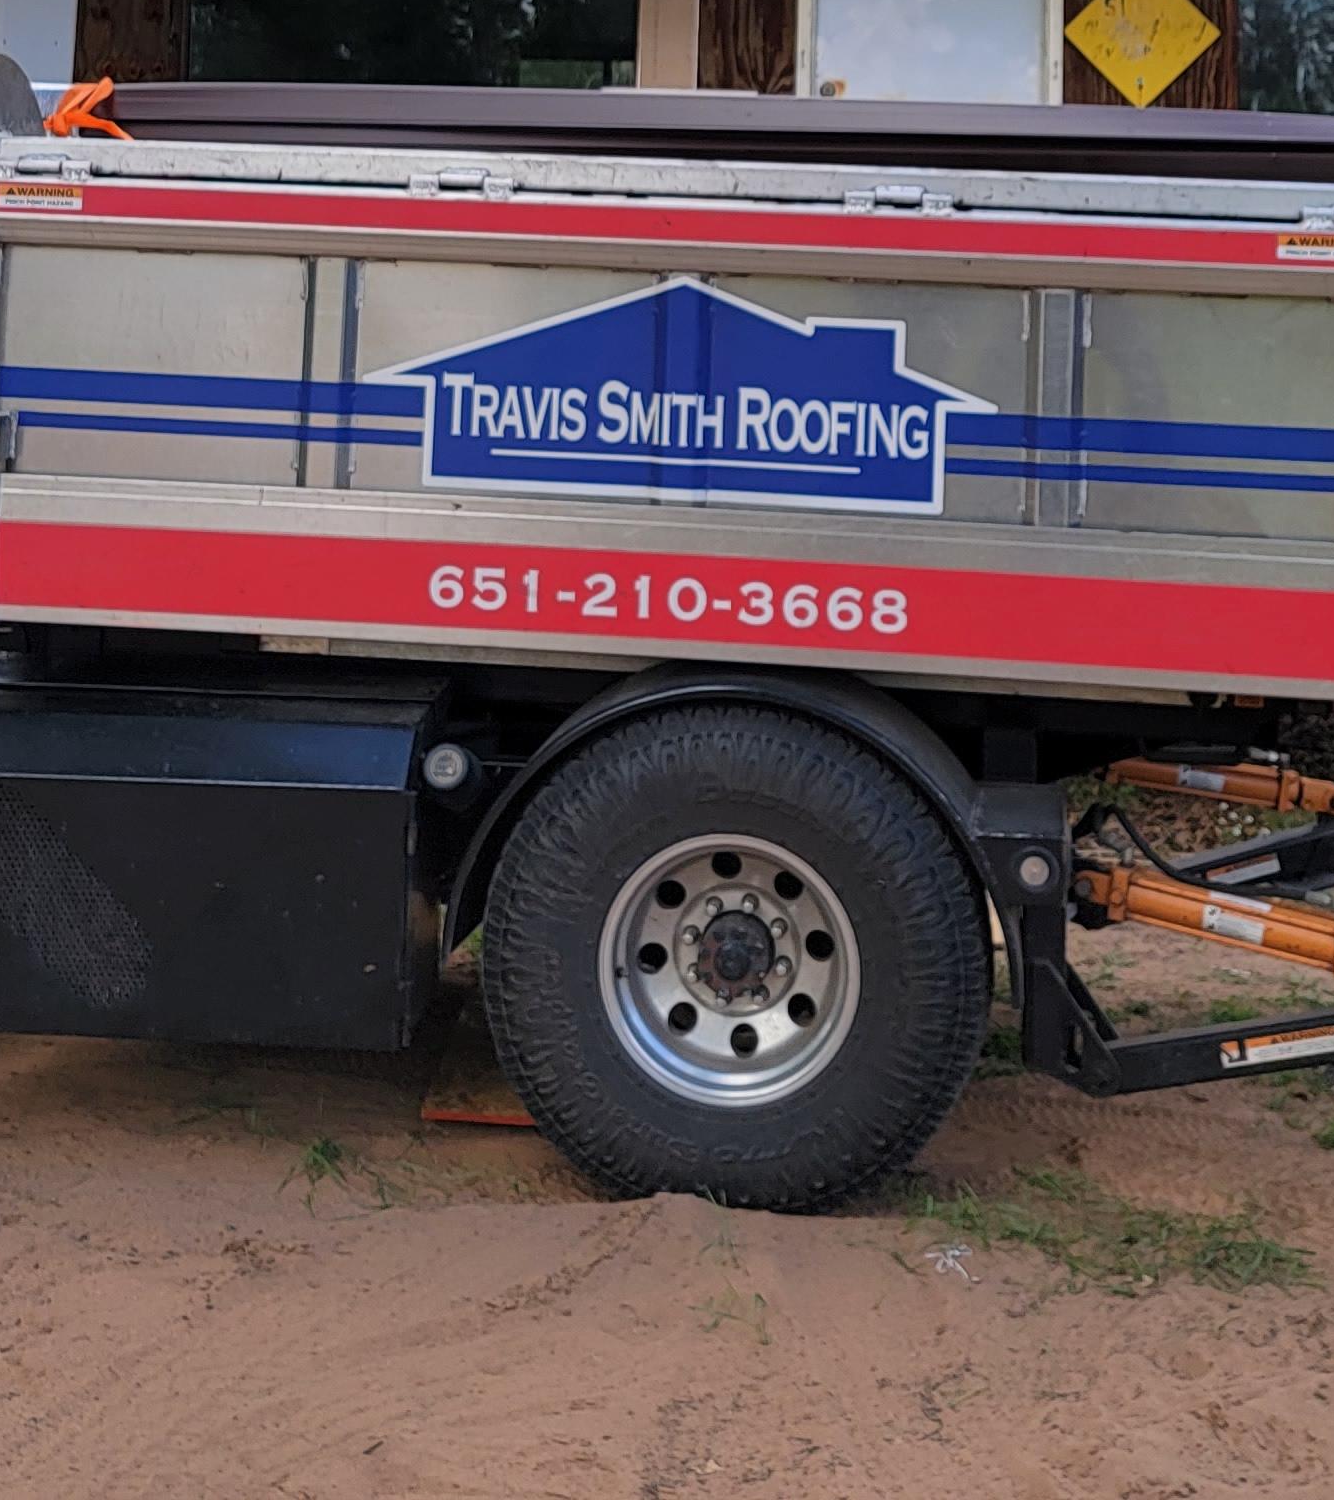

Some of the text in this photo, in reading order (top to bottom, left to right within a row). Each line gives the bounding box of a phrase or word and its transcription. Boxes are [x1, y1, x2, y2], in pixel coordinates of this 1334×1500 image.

[17, 187, 74, 197] WARNING
[443, 371, 930, 460] TRAVIS SMITH ROOFING
[429, 564, 908, 634] 651-210-3668
